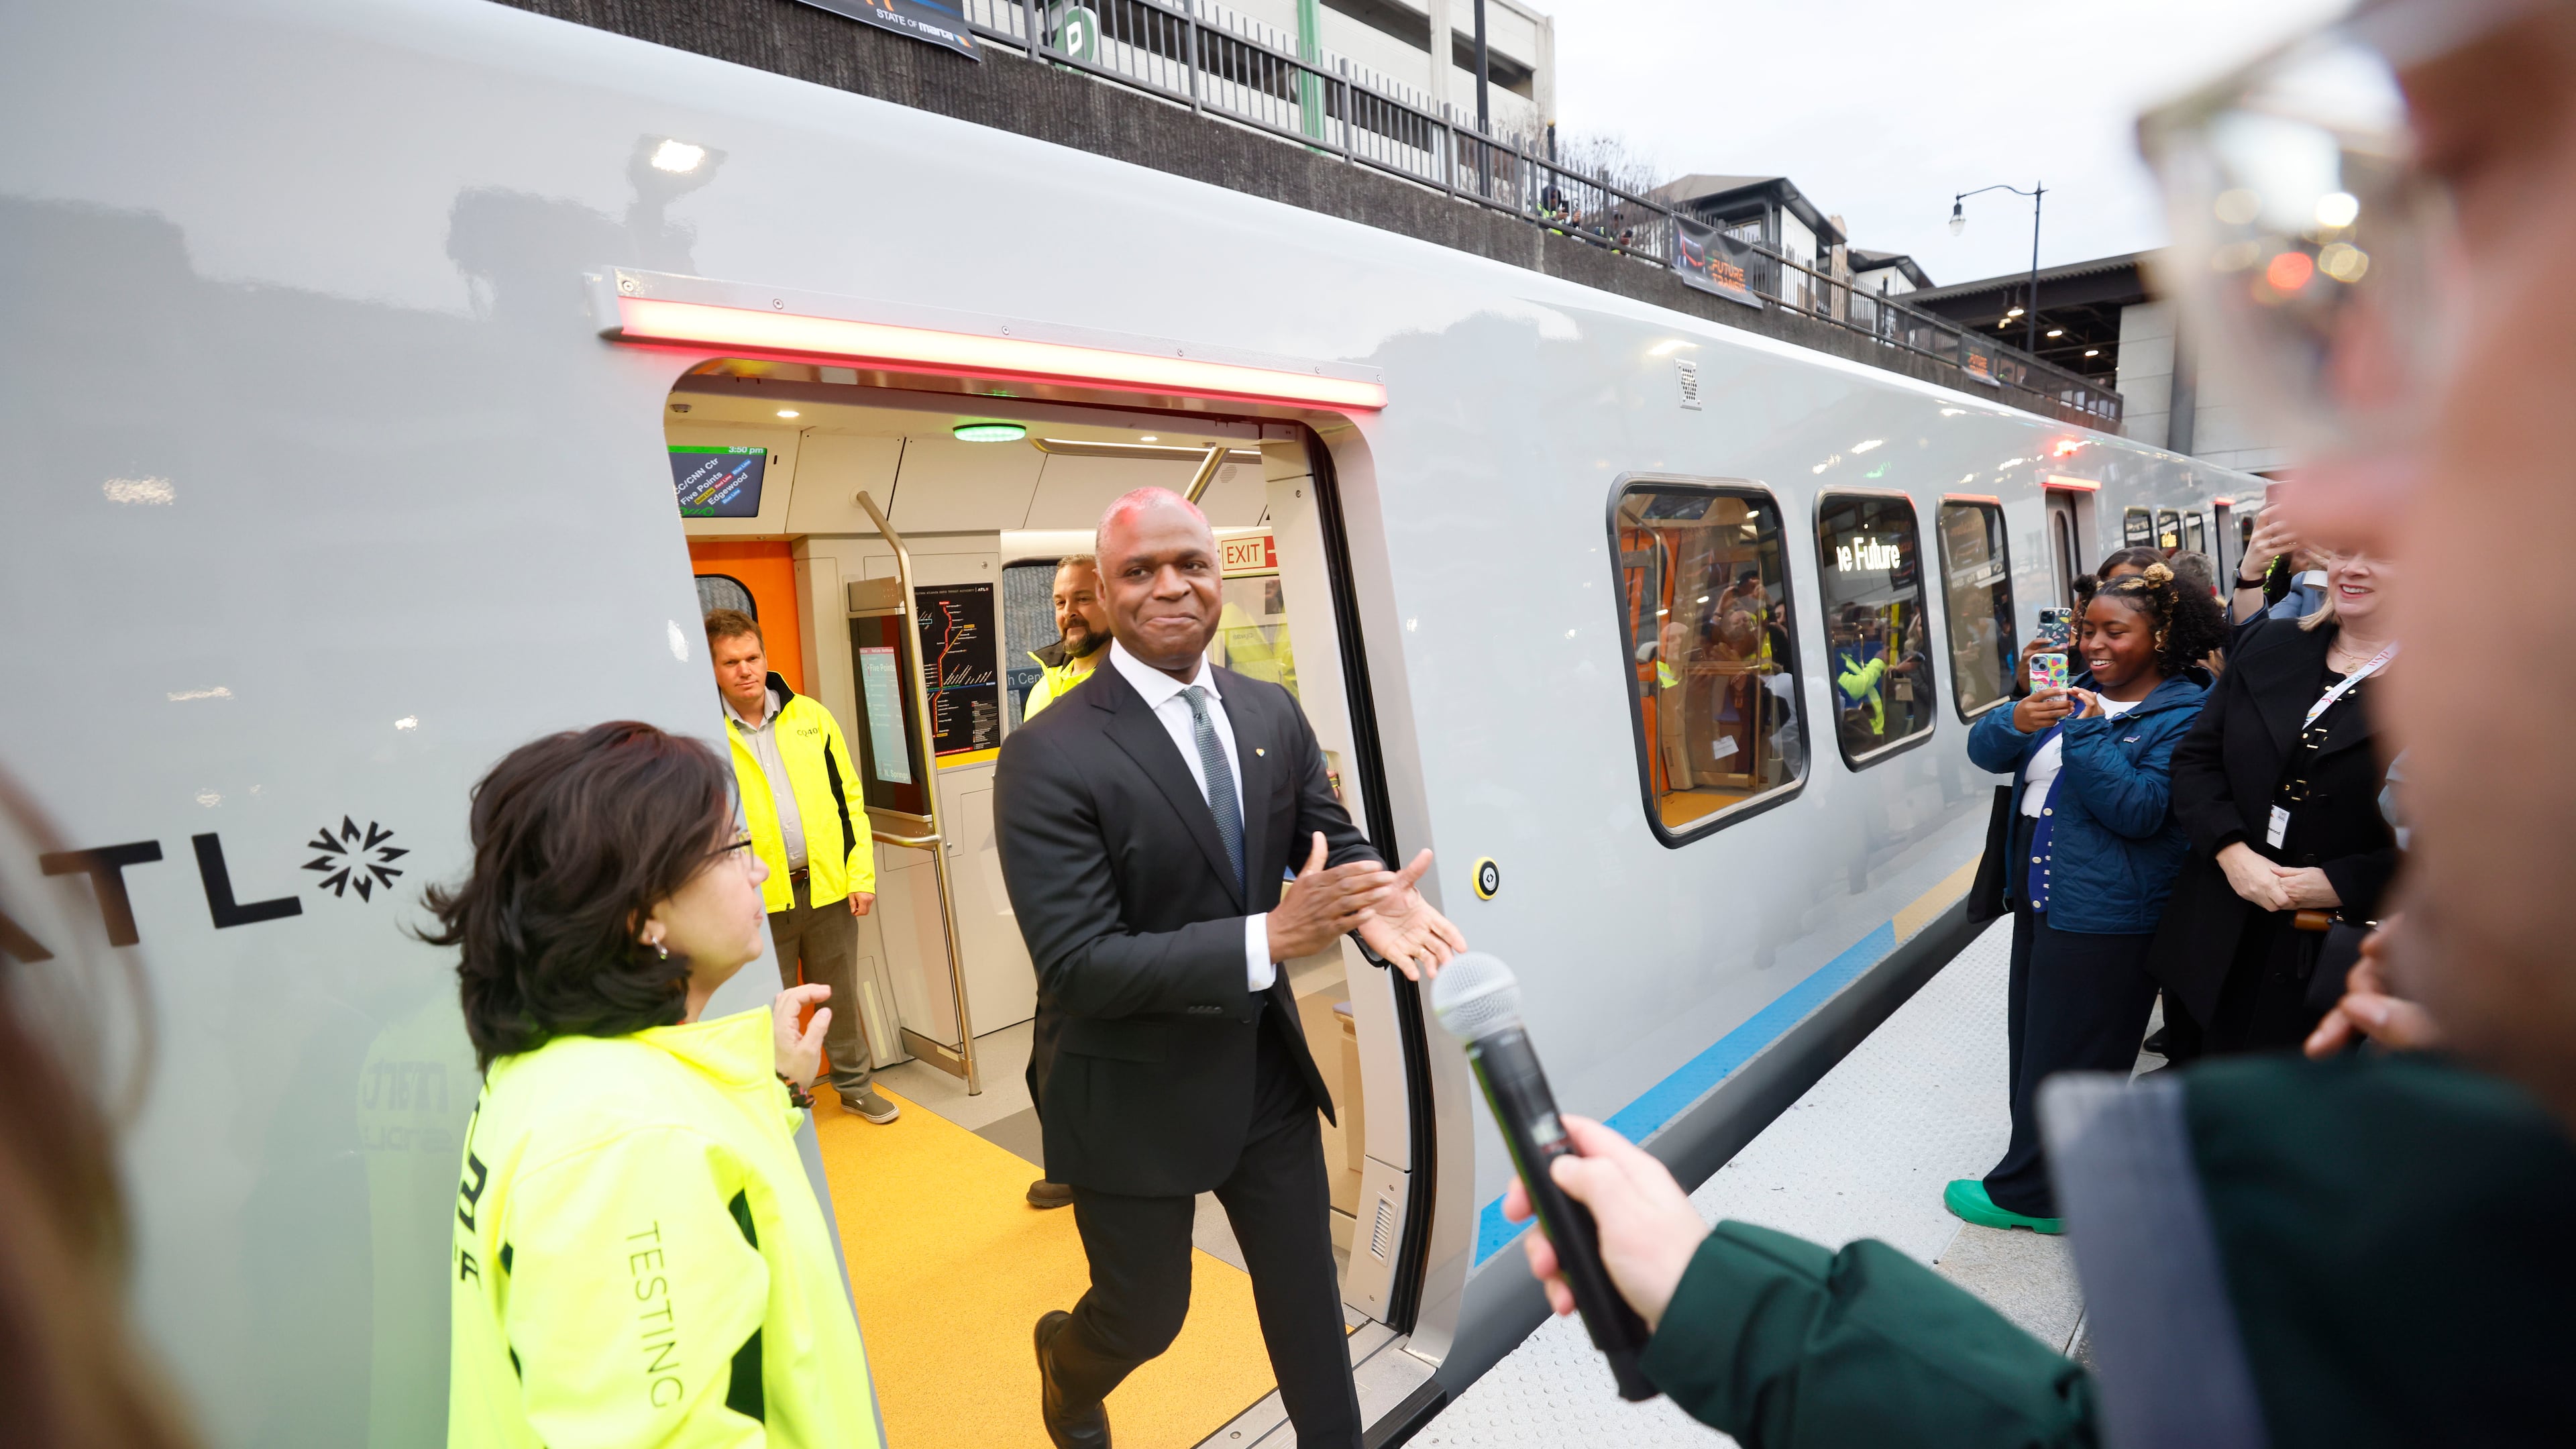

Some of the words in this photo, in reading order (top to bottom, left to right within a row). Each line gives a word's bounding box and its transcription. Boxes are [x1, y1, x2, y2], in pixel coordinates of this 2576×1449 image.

[876, 9, 906, 26] STATE
[907, 19, 917, 28] OF
[918, 21, 954, 42] marta
[1711, 259, 1745, 282] FUTURE
[705, 458, 718, 470] Ctr
[680, 491, 698, 505] Five
[696, 472, 722, 492] Points
[707, 472, 749, 506] Edgewood
[1226, 543, 1260, 564] EXIT
[1854, 537, 1901, 571] Future
[870, 663, 879, 672] Five
[879, 663, 896, 672] Points
[890, 769, 909, 781] Springs
[627, 1220, 684, 1408] TESTING
